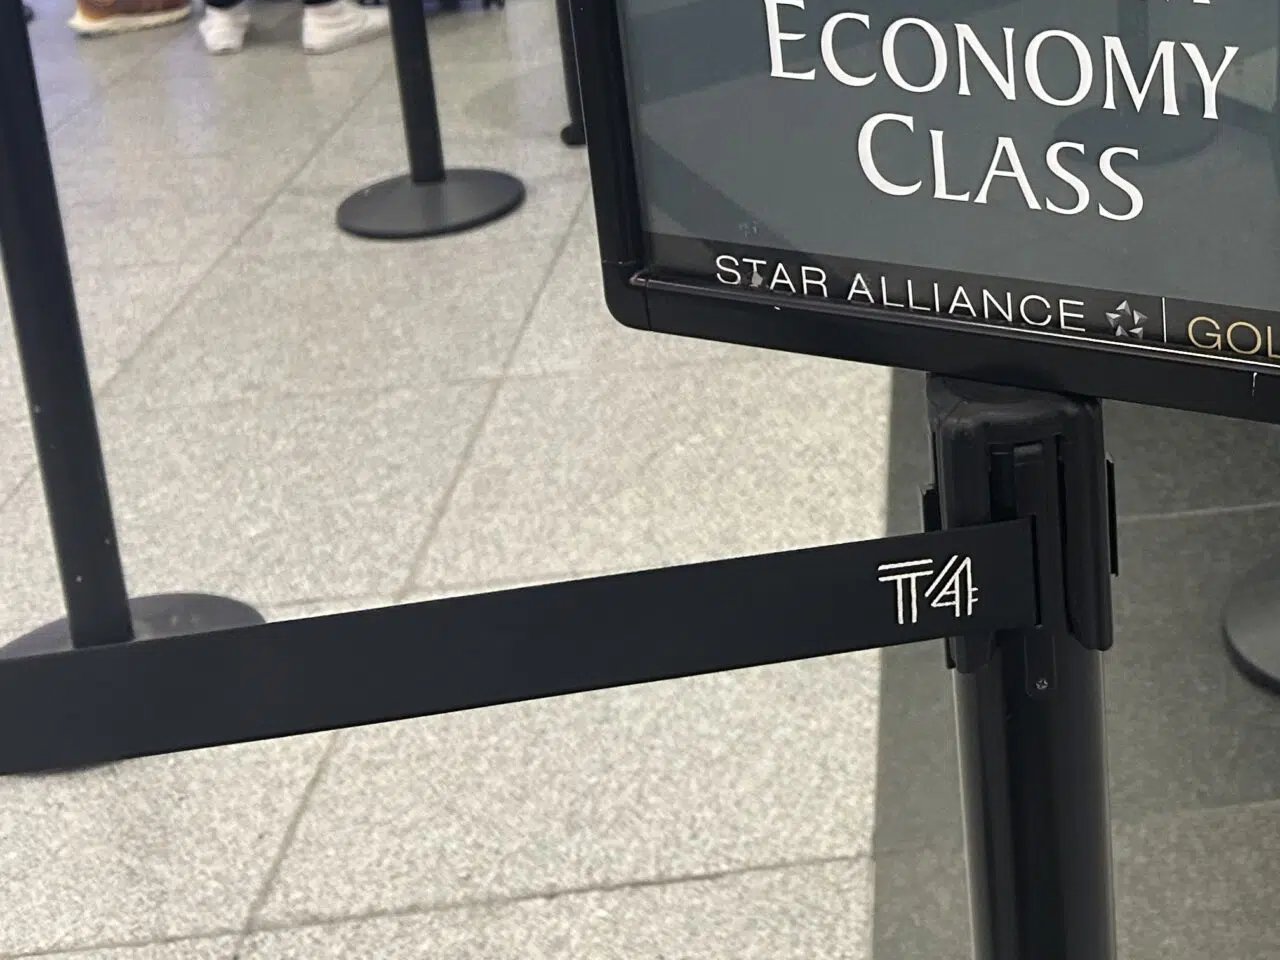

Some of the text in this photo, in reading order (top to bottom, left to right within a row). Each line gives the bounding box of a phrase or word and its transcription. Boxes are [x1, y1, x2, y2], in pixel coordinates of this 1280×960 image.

[857, 112, 1144, 222] CLASS
[716, 254, 828, 298] STAR
[847, 271, 1086, 332] ALLIANCE
[877, 554, 979, 625] T4
